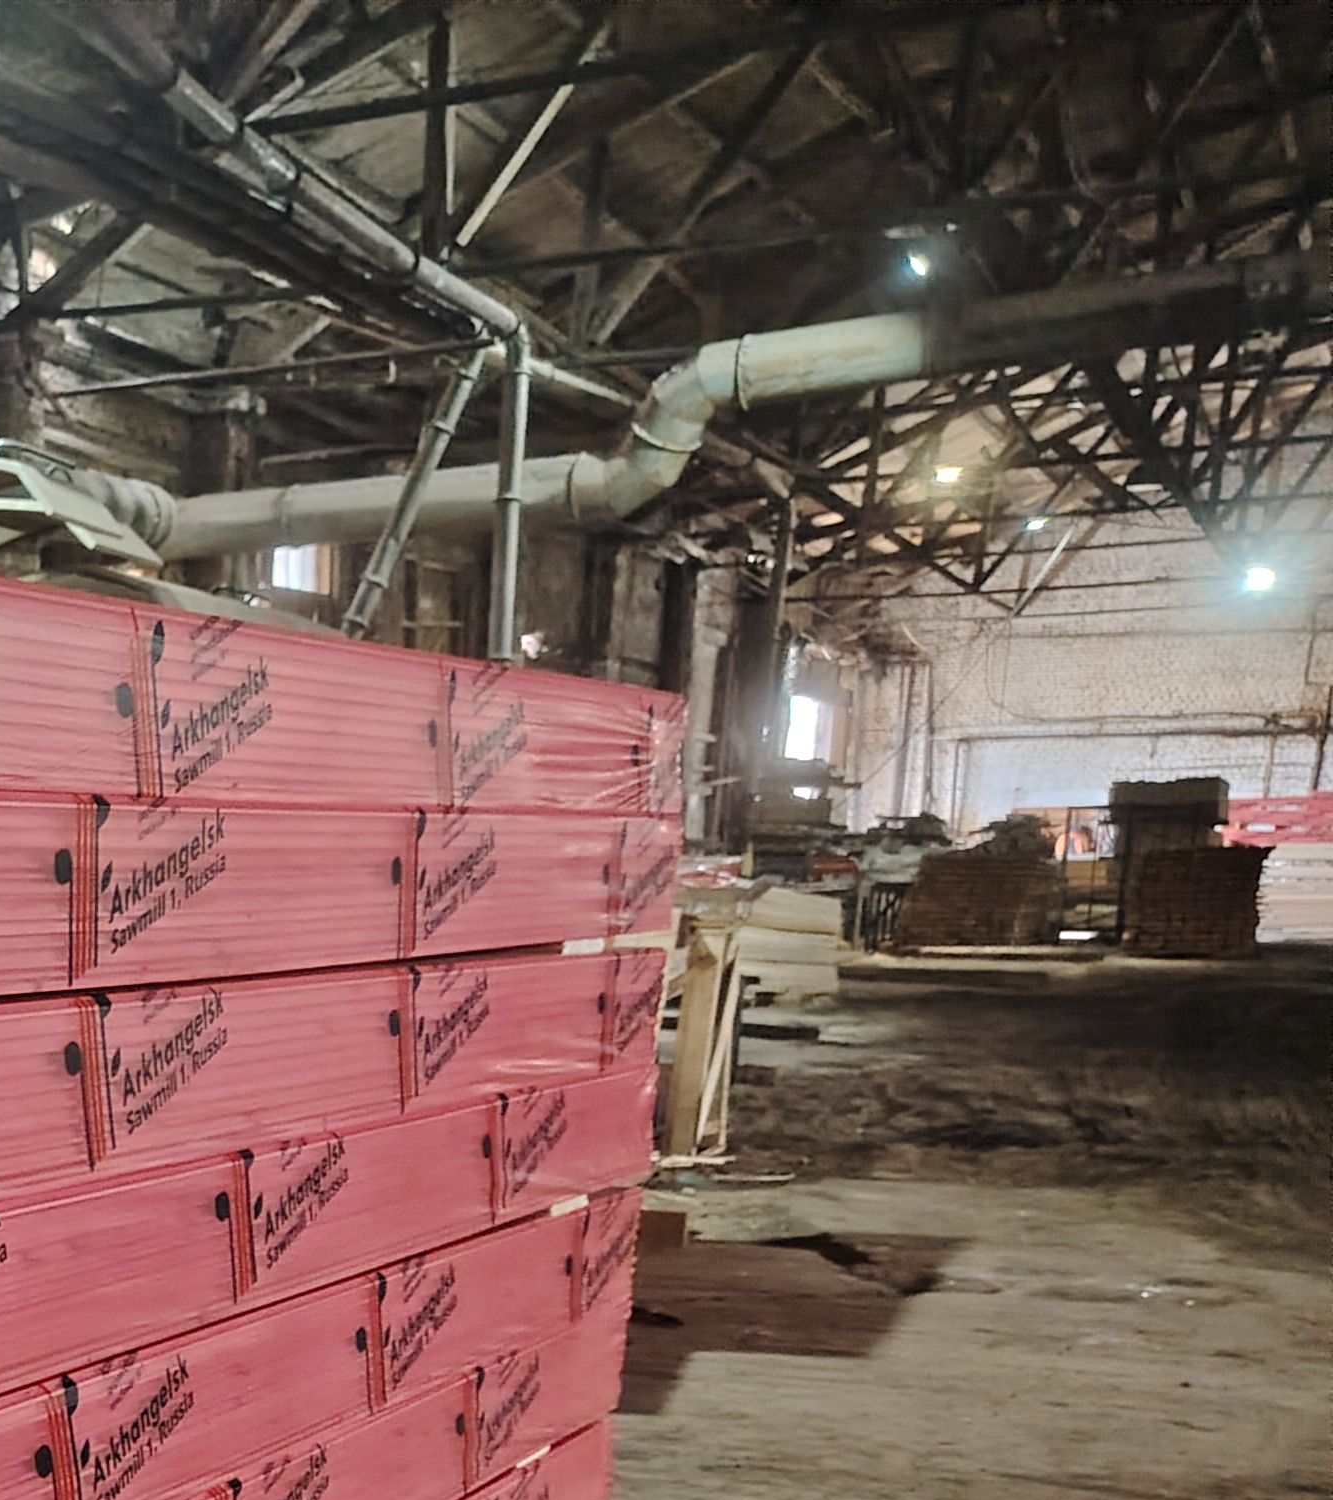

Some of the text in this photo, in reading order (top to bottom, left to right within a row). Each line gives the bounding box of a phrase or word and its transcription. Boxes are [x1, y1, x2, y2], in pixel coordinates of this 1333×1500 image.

[172, 655, 268, 762] Arkhangelsk
[109, 807, 225, 924] Arkhangelsk
[123, 987, 224, 1107] Arkhangelsk
[264, 1132, 345, 1245] Arkhangelsk
[93, 1353, 189, 1492] Arkhangelsk
